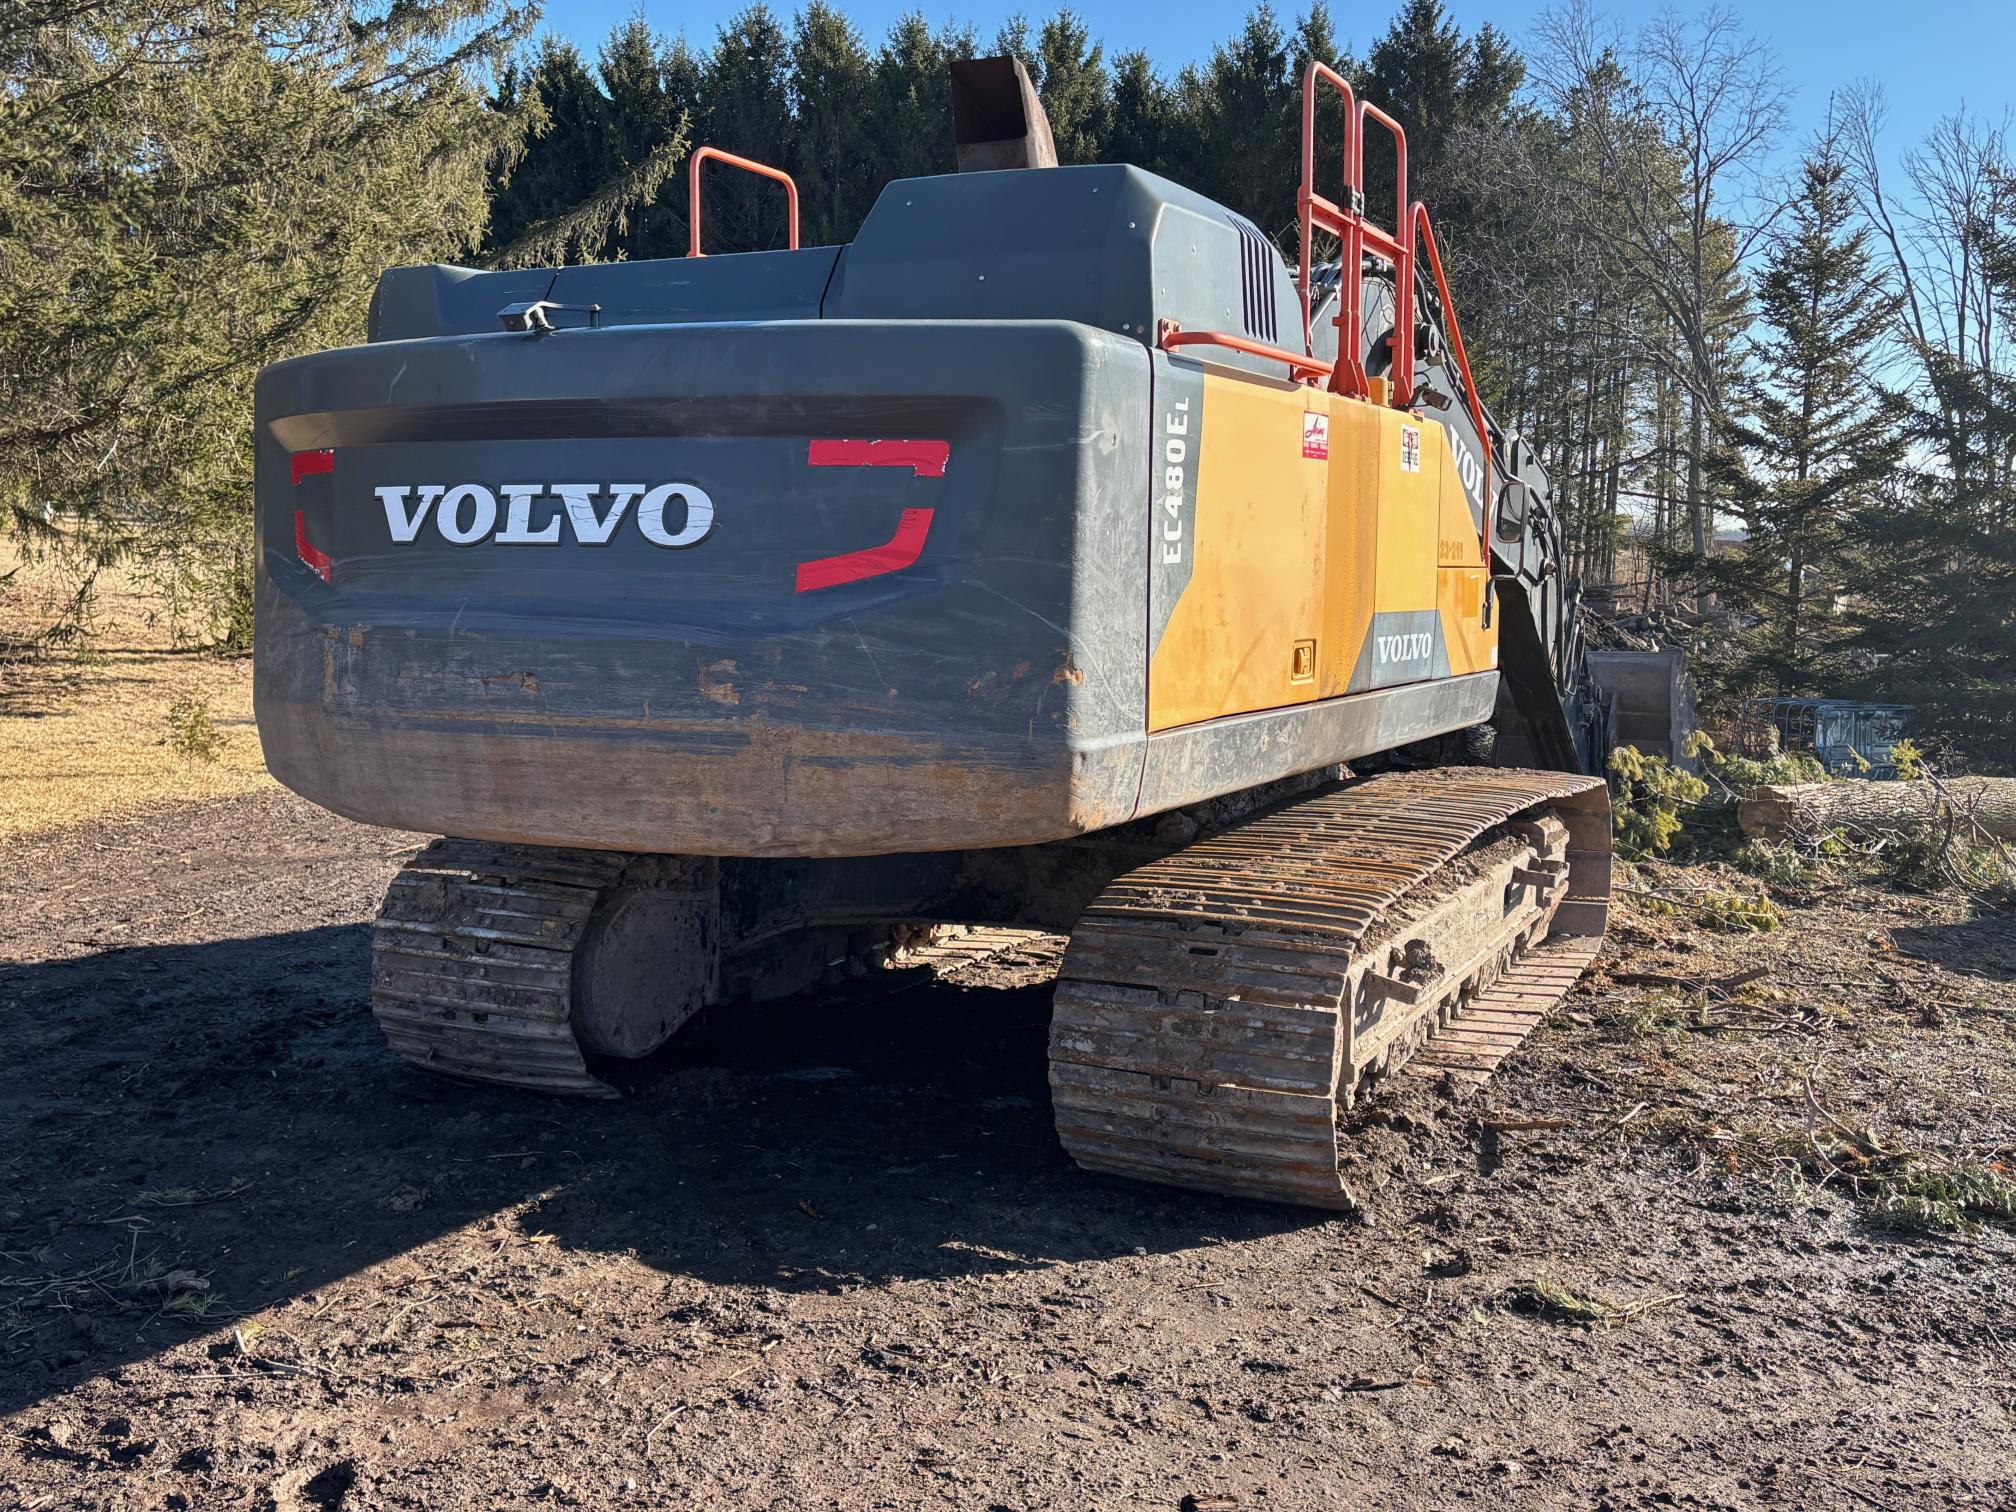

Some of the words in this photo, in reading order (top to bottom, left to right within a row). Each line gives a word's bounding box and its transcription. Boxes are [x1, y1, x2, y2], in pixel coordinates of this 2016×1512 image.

[1163, 397, 1189, 564] EC480EL
[1450, 424, 1498, 522] VOL
[374, 482, 714, 546] VOLVO
[1377, 632, 1432, 664] VOLVO
